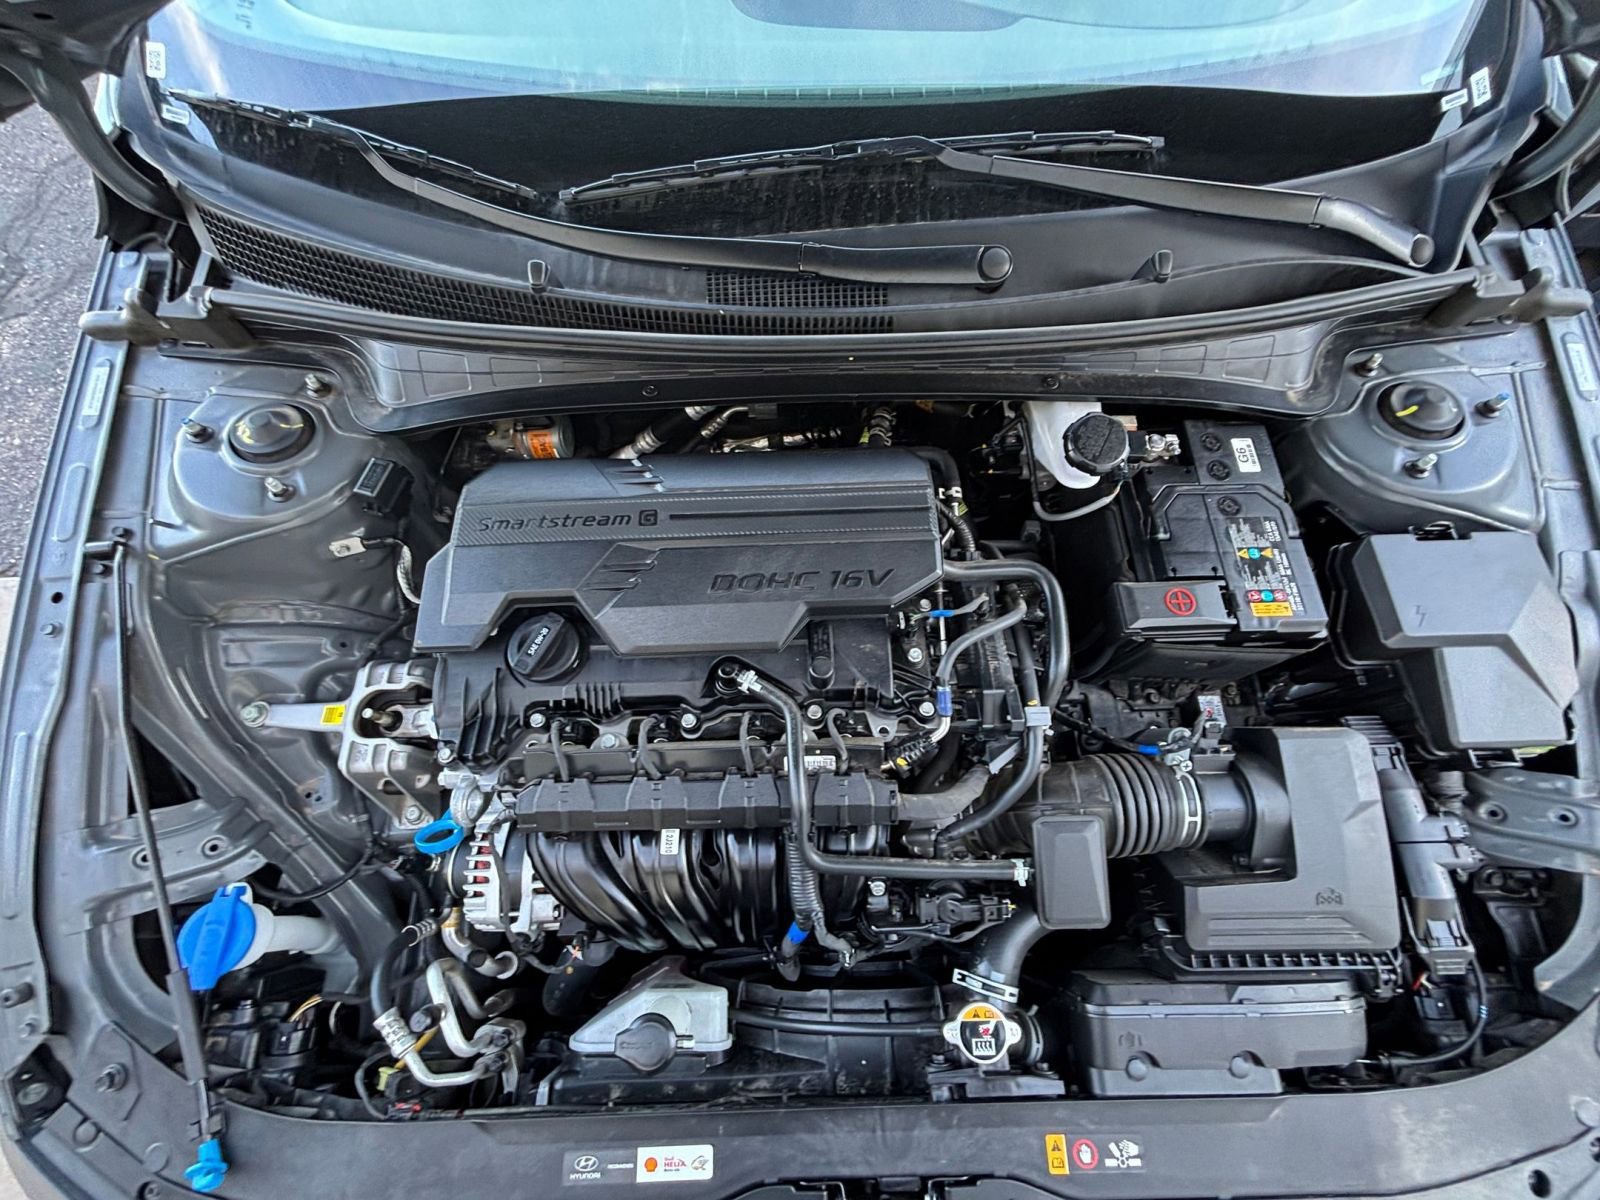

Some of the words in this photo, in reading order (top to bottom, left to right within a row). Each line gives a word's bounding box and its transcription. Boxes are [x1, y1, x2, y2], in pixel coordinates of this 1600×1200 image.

[1235, 447, 1250, 463] G6
[478, 513, 632, 532] Smartstream
[707, 571, 821, 594] DOHC
[831, 568, 896, 590] 16V
[527, 643, 539, 656] SAE
[570, 1172, 601, 1180] HYUNDAI
